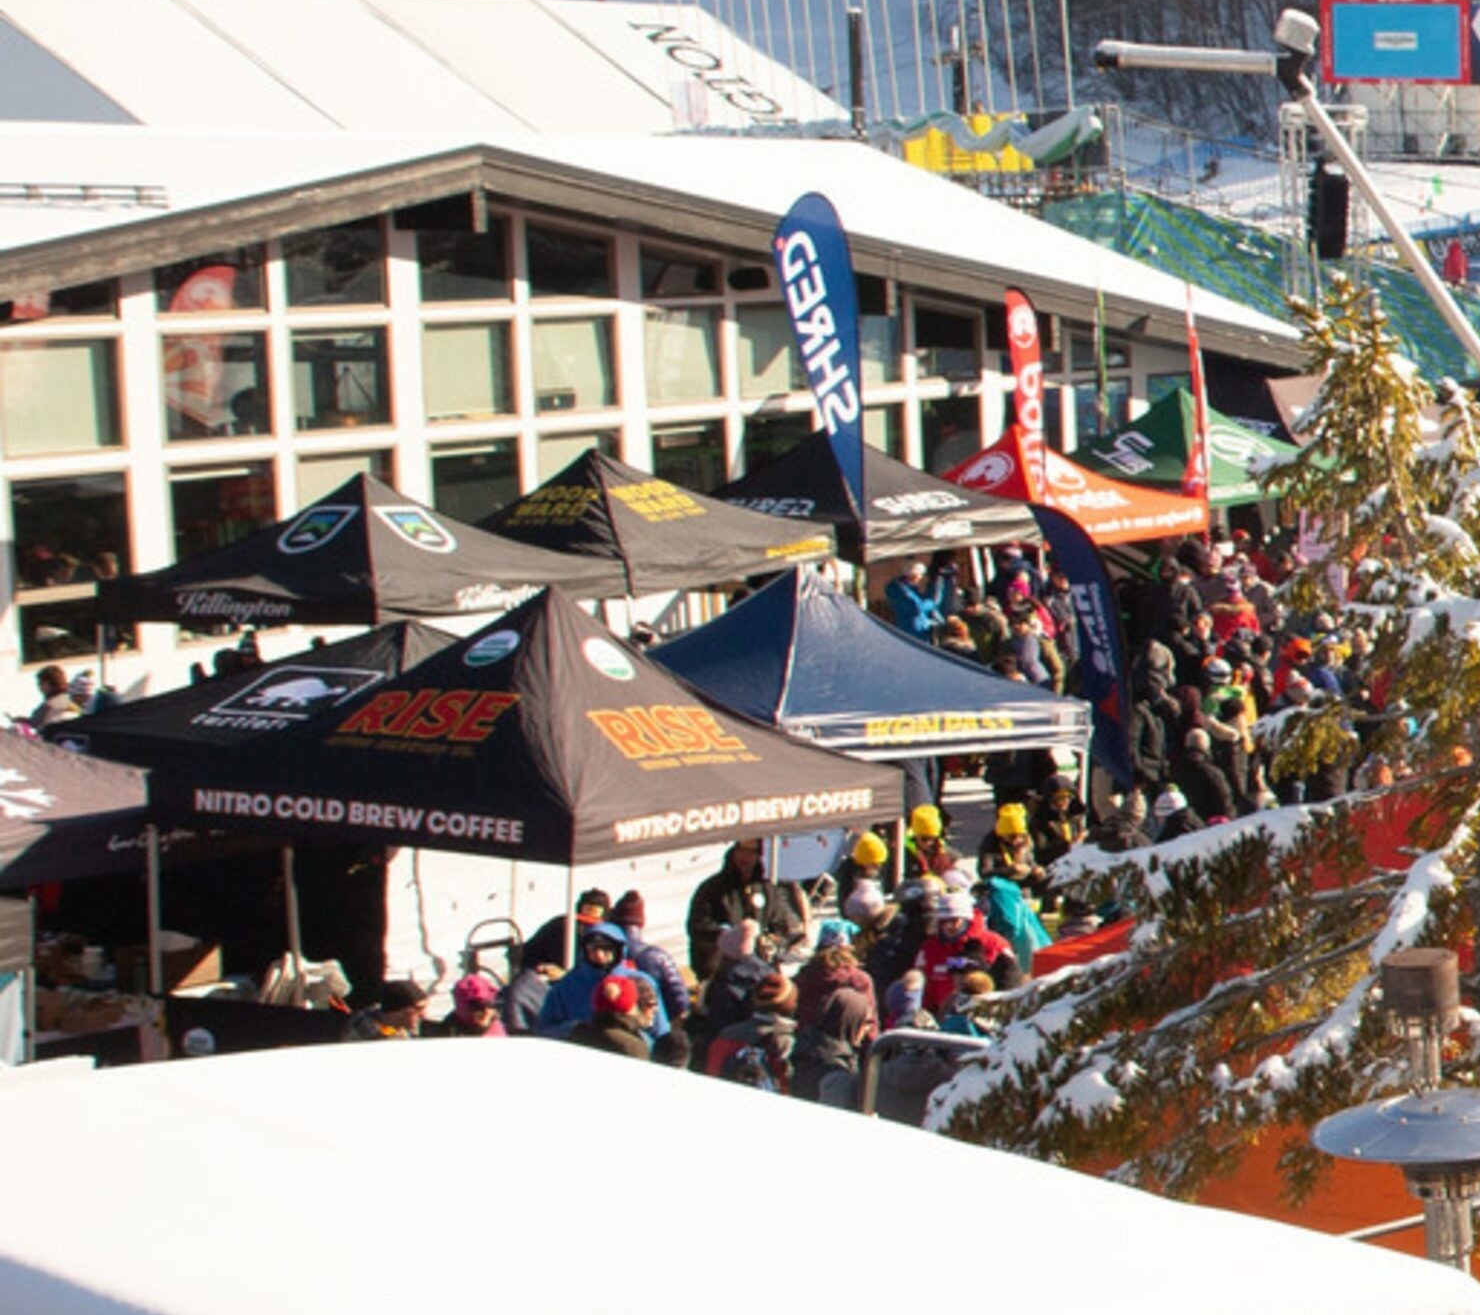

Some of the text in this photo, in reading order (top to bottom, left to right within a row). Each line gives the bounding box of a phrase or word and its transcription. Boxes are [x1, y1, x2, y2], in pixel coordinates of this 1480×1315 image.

[175, 590, 292, 623] Killington
[337, 688, 521, 743] RISE
[586, 705, 747, 760] RISE
[195, 788, 525, 844] NITRO COLD BREW COFFEE
[613, 788, 873, 844] NITRO COLD BREW COFFEE
